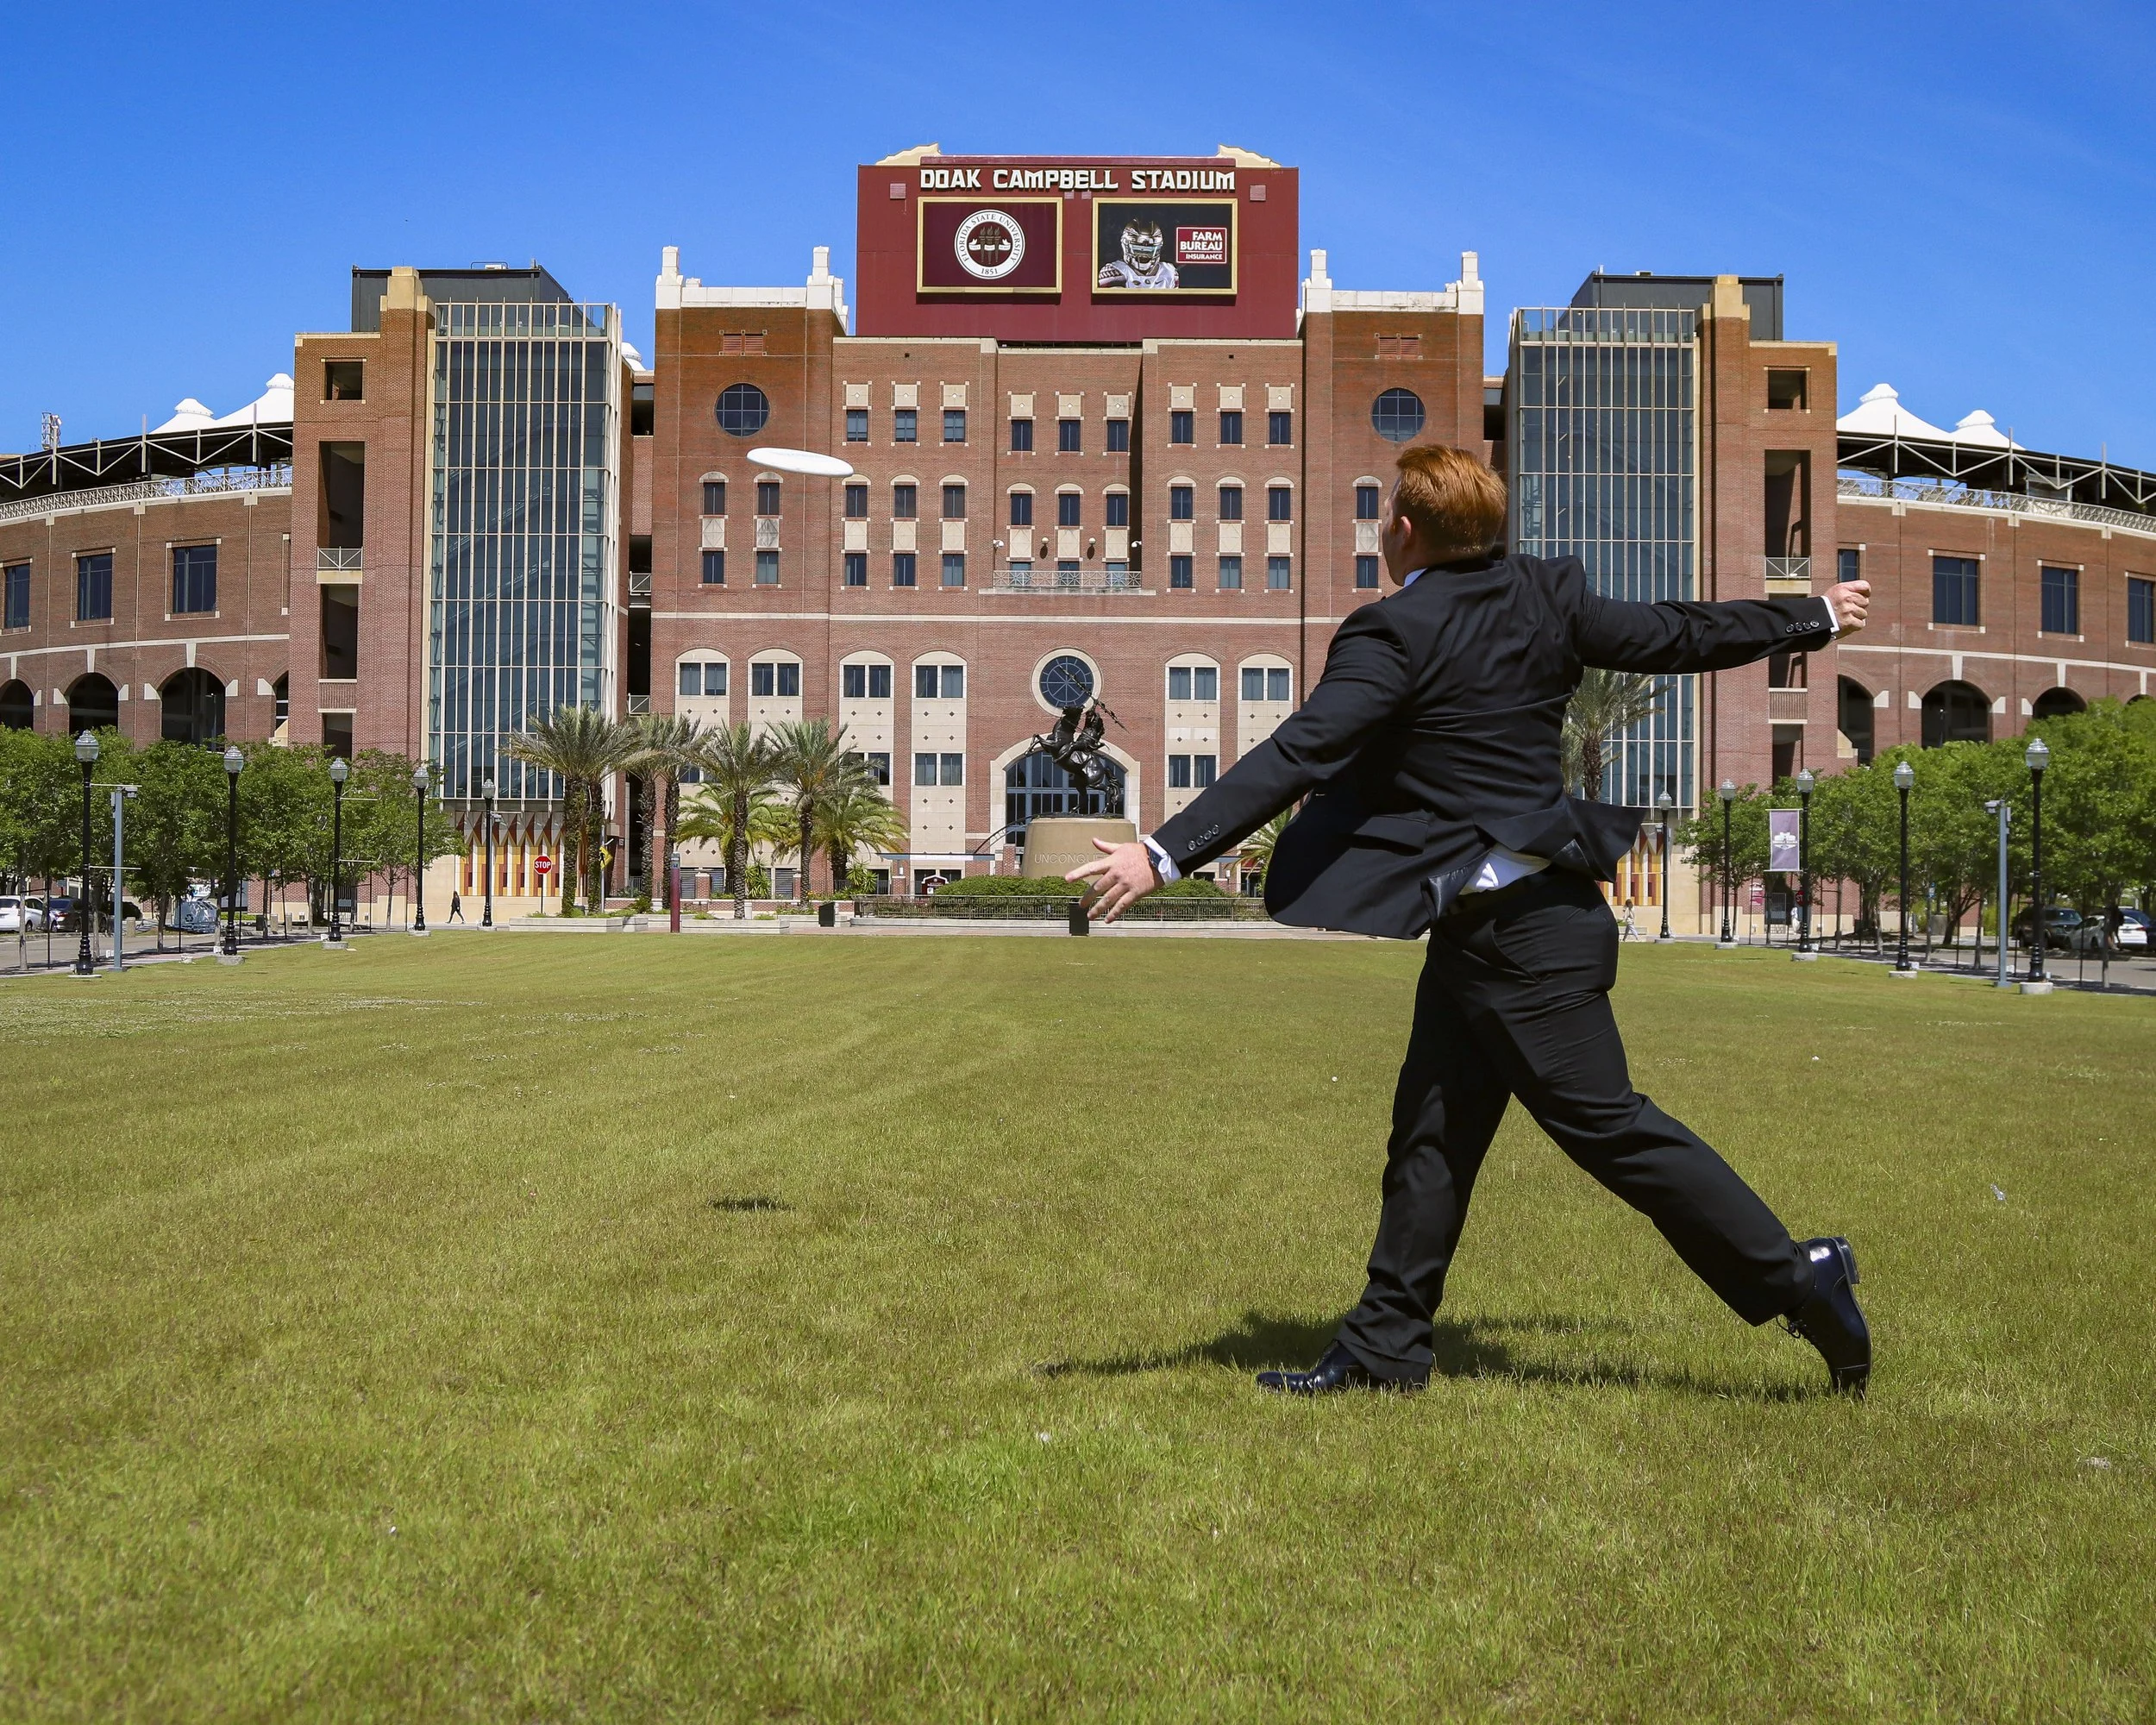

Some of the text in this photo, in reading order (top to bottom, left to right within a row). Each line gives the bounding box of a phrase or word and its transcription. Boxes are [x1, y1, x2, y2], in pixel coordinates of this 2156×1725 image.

[920, 169, 1235, 190] DOAK CAMPBELL STADIUM
[959, 214, 1021, 262] FLORIDA STATE UNIVERSITY
[1193, 231, 1223, 241] FARM
[1180, 241, 1223, 250] BUREAU
[1035, 852, 1111, 863] UNCONQUE
